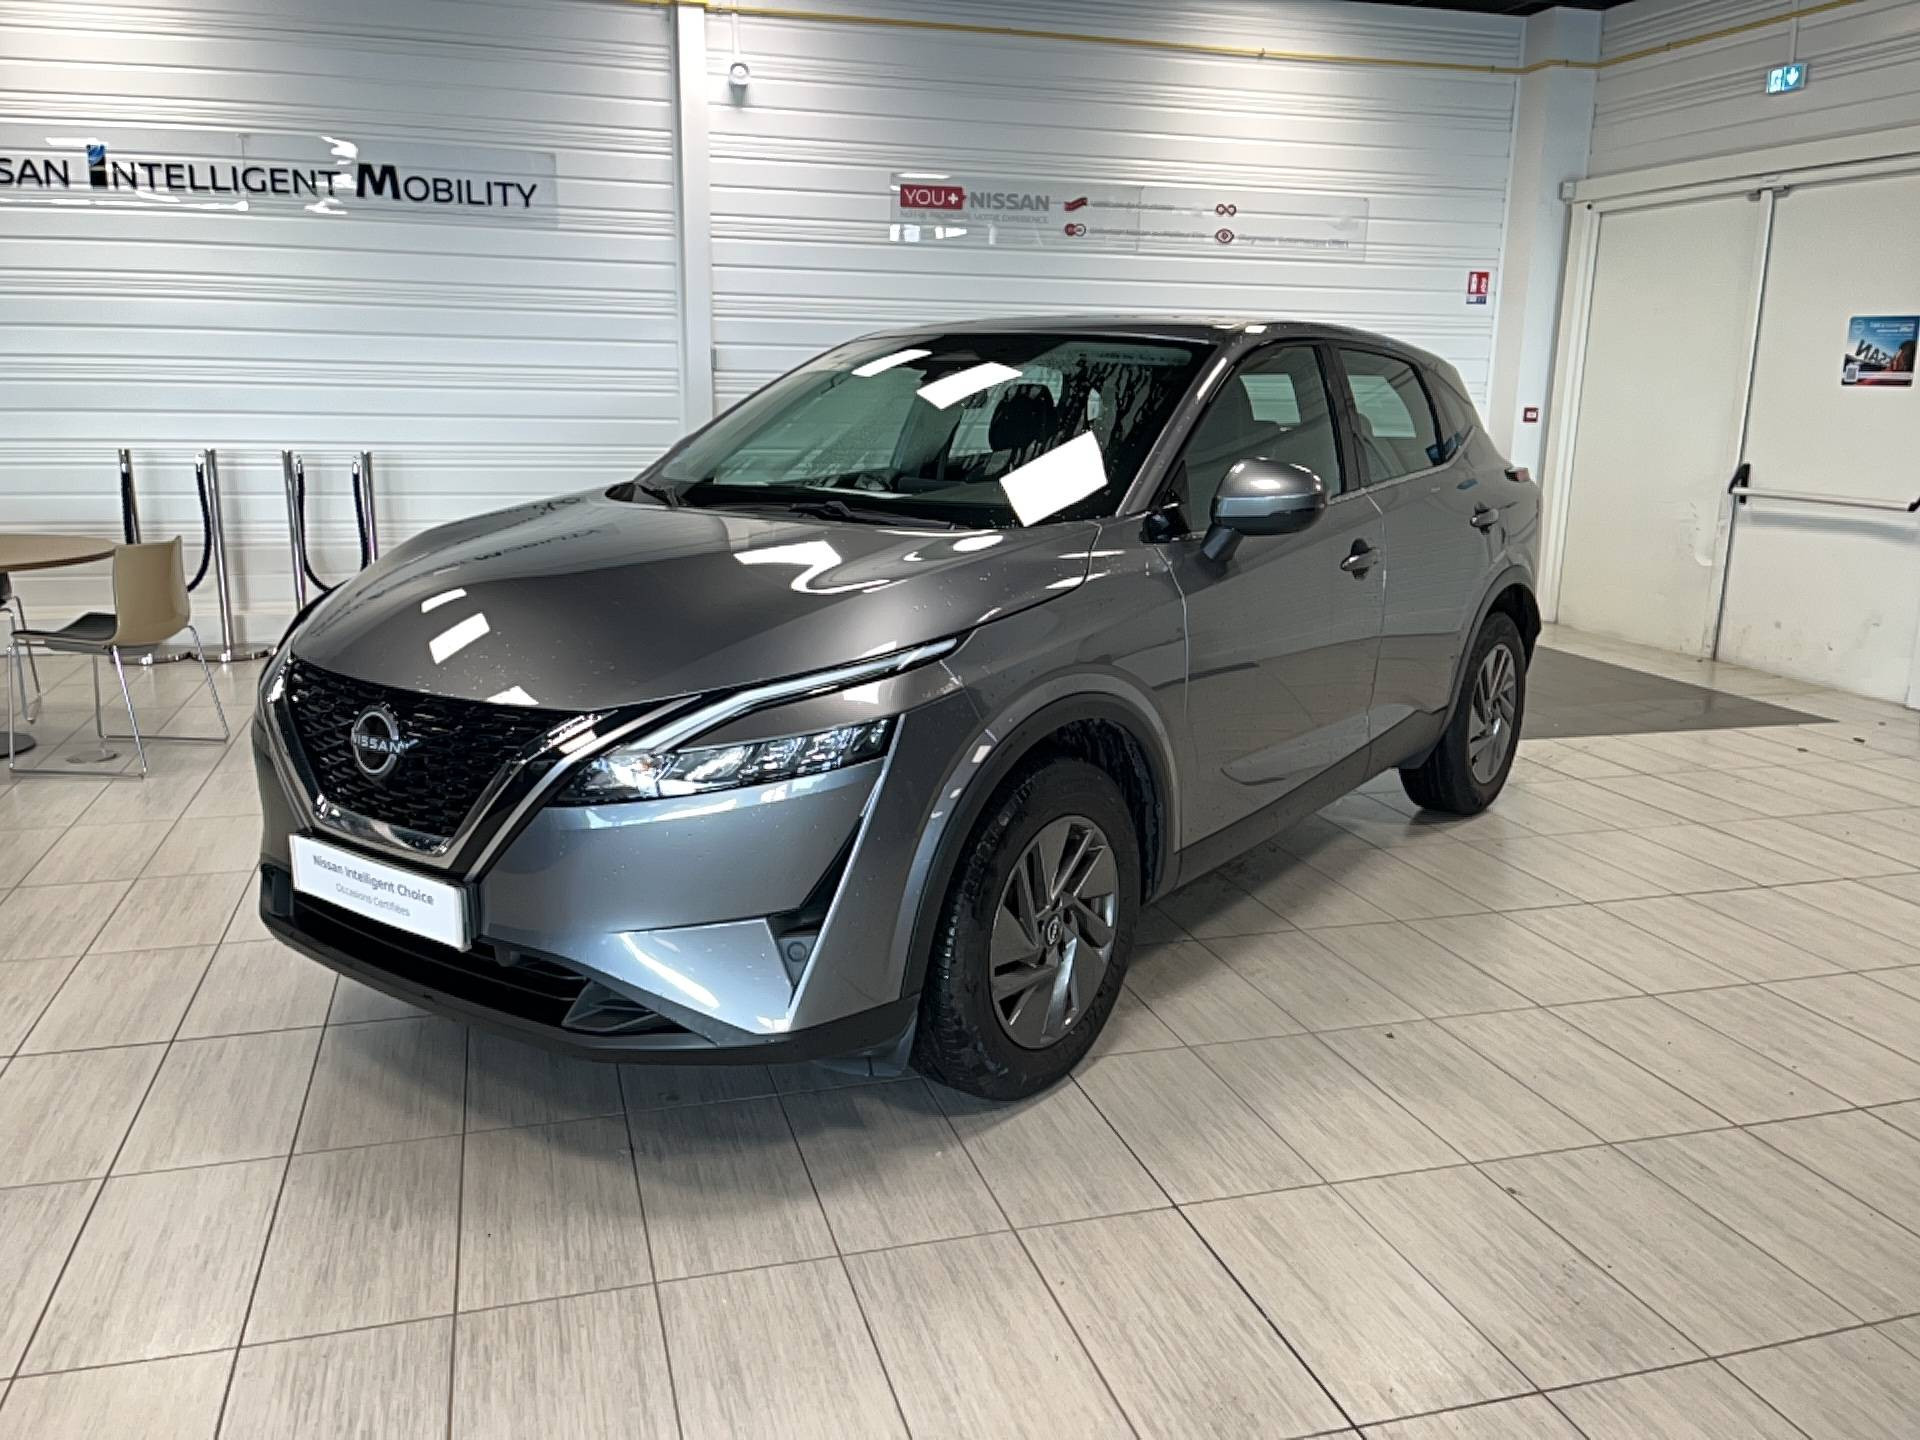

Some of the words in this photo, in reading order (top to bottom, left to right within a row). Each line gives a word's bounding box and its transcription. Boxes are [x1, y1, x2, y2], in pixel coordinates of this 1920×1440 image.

[86, 144, 342, 197] INTELLIGENT
[356, 162, 537, 208] MOBILITY
[970, 191, 1049, 211] NISSAN
[352, 732, 401, 754] NISSAN
[312, 854, 343, 873] Nissan
[345, 866, 395, 893] Intelligent
[397, 883, 435, 906] Choice
